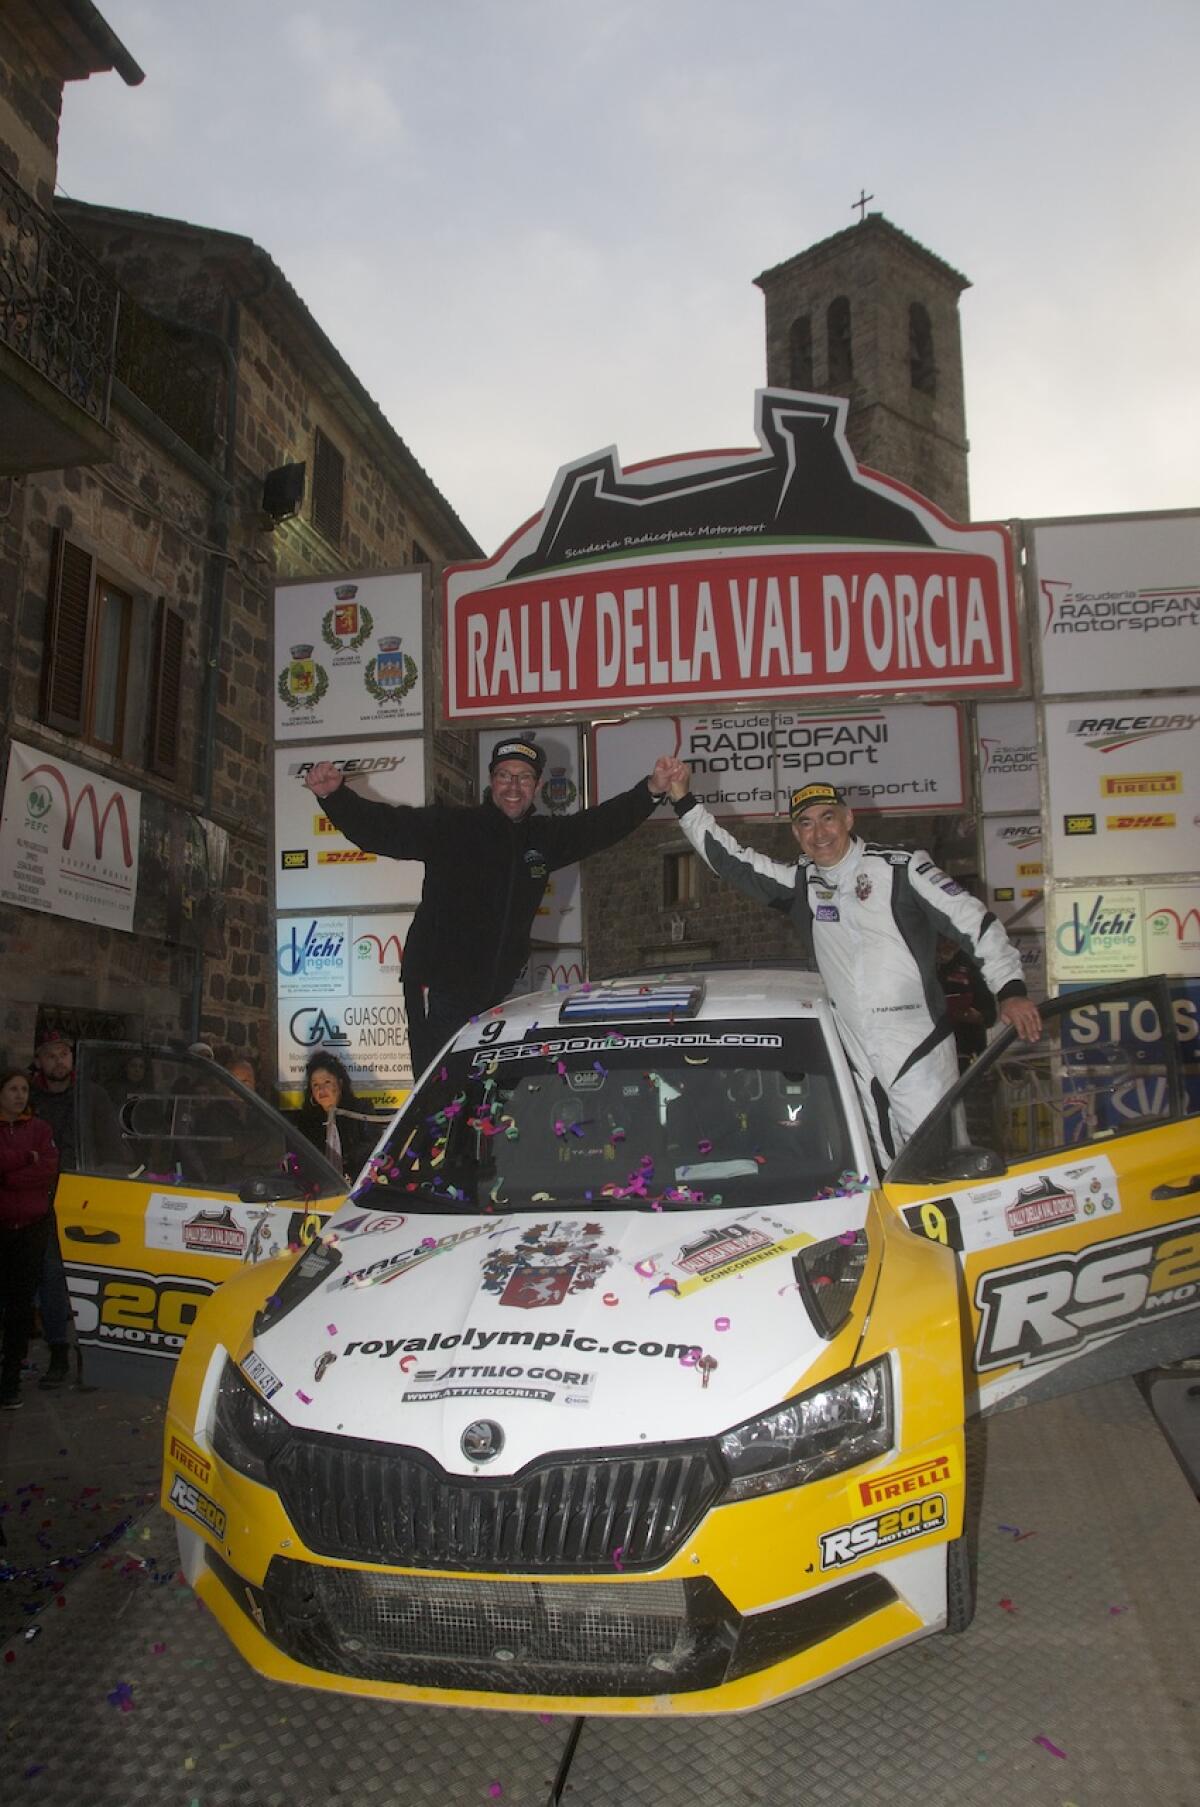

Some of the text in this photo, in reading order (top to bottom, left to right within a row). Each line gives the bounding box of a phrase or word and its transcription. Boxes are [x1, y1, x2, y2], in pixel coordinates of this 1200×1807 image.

[565, 522, 766, 559] Scuderia Radicofani Motorsport
[1075, 590, 1136, 602] Scuderia
[467, 572, 994, 697] RALLY DELLA VAL D'ORCIA
[1053, 611, 1200, 634] motorsport
[711, 713, 794, 729] Scuderia
[1077, 714, 1200, 733] RACEDAY
[690, 724, 889, 753] RADICOFANI
[683, 744, 878, 773] motorsport
[1106, 775, 1177, 794] PIRELLI
[1117, 815, 1168, 829] DHL
[326, 852, 369, 862] DHL
[359, 1028, 409, 1046] ANDREA
[479, 1021, 506, 1044] 9
[920, 1203, 949, 1246] 9
[702, 1244, 787, 1283] CONCORRENTE
[343, 1328, 703, 1358] royalolympic.com
[436, 1365, 588, 1386] ATTILIO GORI
[406, 1386, 549, 1401] WWW.ATTILIOGORI.IT
[171, 1436, 212, 1484] PIRELLI
[858, 1456, 950, 1507] PIRELLI
[822, 1497, 944, 1566] RS200
[878, 1517, 944, 1545] MOTOR OIL
